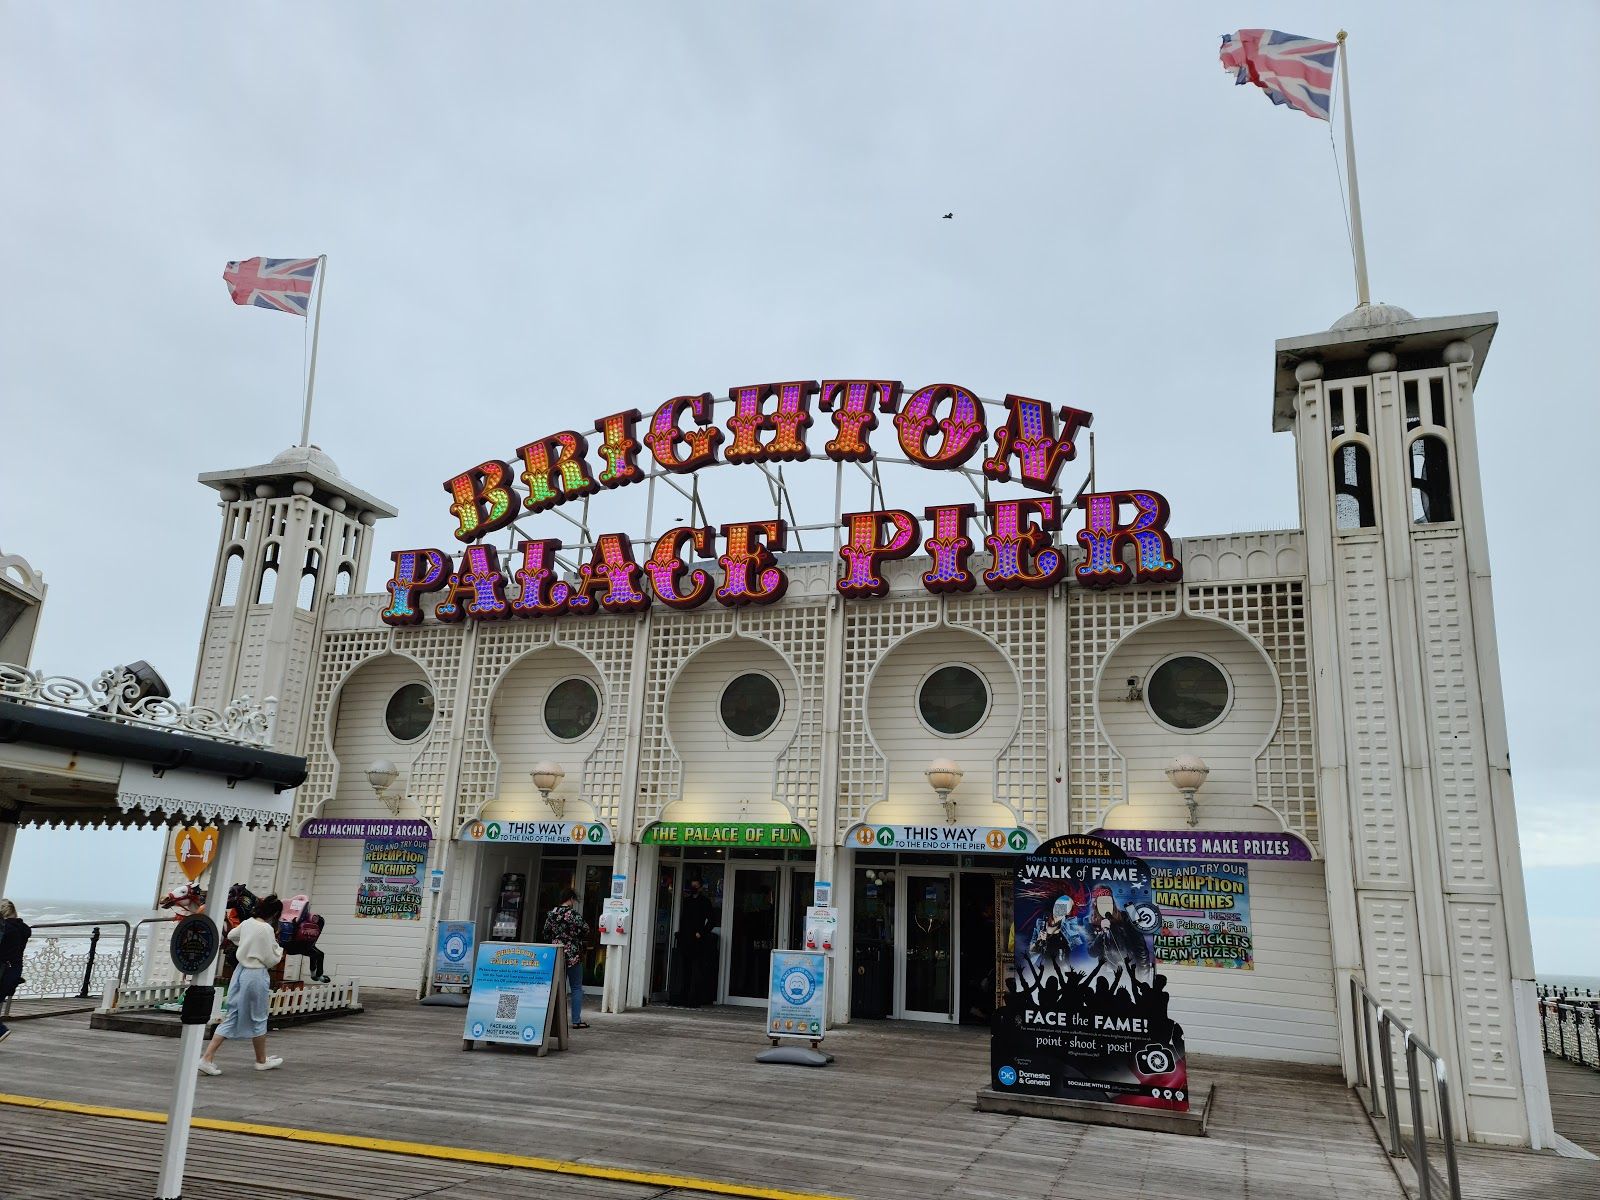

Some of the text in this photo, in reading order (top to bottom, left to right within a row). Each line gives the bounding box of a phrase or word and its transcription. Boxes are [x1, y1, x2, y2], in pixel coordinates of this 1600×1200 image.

[444, 380, 1093, 543] BRIGHTON
[381, 490, 1183, 626] PALACE PIER
[308, 824, 428, 836] CASH MACHINE INSIDE ARCADE
[508, 822, 565, 835] THIS WAY
[652, 827, 800, 843] THE PALACE OF FUN
[904, 827, 977, 841] THIS WAY
[366, 843, 383, 852] COME
[414, 840, 427, 849] OUR
[1055, 838, 1104, 848] BRIGHTON
[1104, 837, 1290, 856] HERE TICKETS MAKE PRIZES
[365, 850, 424, 863] REDEMPTION
[369, 863, 416, 875] MACHINES
[1026, 865, 1138, 881] WALK of FAME
[1151, 864, 1246, 878] OME AND TRY OUR
[358, 894, 421, 904] WHERE TICKETS
[1156, 892, 1234, 909] MACHINES
[359, 905, 383, 914] MEAN
[1177, 919, 1210, 930] Palace
[1213, 921, 1225, 933] of
[1227, 922, 1248, 933] Fun
[1195, 934, 1250, 949] TICKETS
[1025, 1010, 1149, 1033] FACE the FAME!
[1036, 1036, 1062, 1048] point
[1070, 1036, 1097, 1050] shoot
[1107, 1041, 1132, 1054] post!
[1019, 1070, 1050, 1080] Domestic
[1026, 1079, 1050, 1087] General
